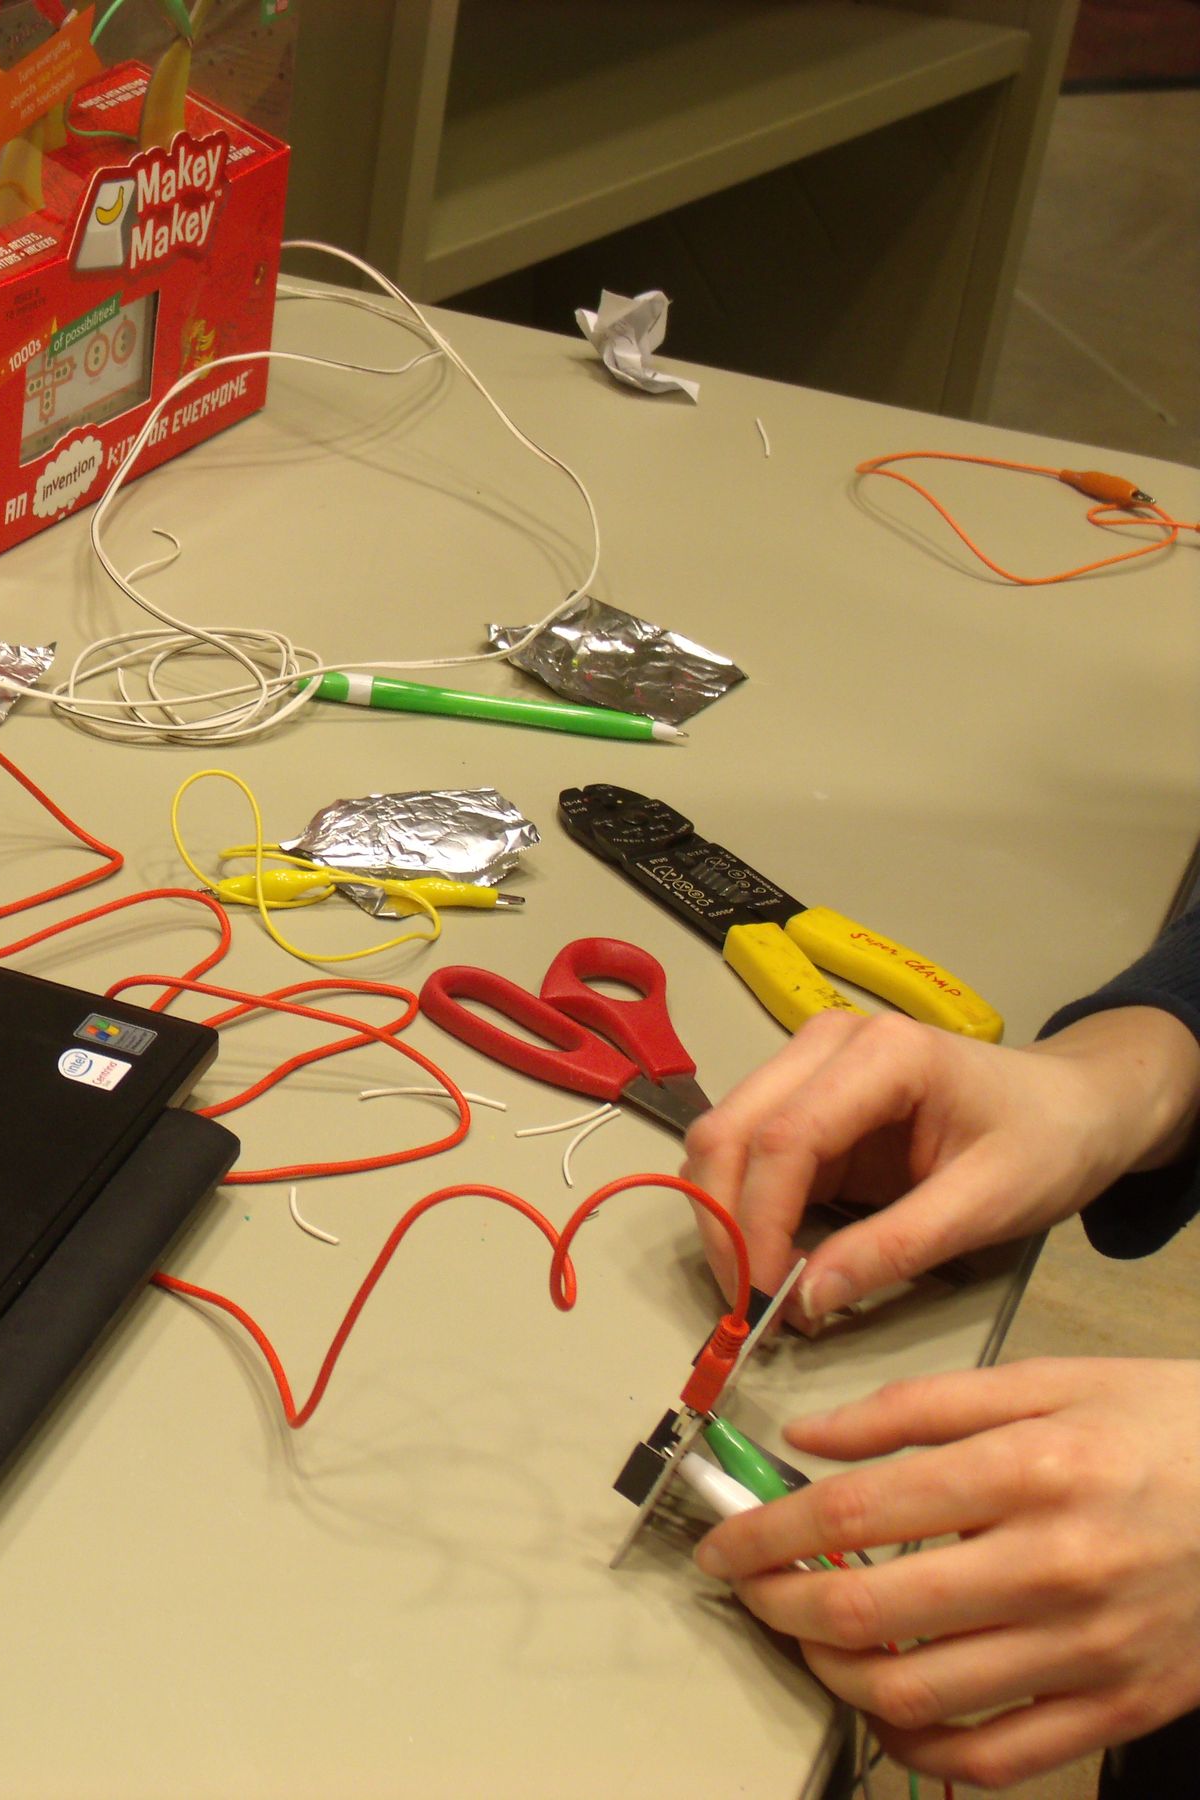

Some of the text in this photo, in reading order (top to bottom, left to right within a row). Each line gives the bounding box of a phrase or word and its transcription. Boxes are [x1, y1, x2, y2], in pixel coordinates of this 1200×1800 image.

[137, 144, 222, 213] Makey
[129, 200, 216, 270] Makey
[8, 338, 42, 373] 1000s
[53, 332, 65, 352] of
[64, 299, 116, 350] possibilities!
[41, 455, 96, 502] invention
[106, 434, 137, 471] KIT
[171, 370, 250, 435] EVERYONE
[66, 1053, 87, 1074] intel
